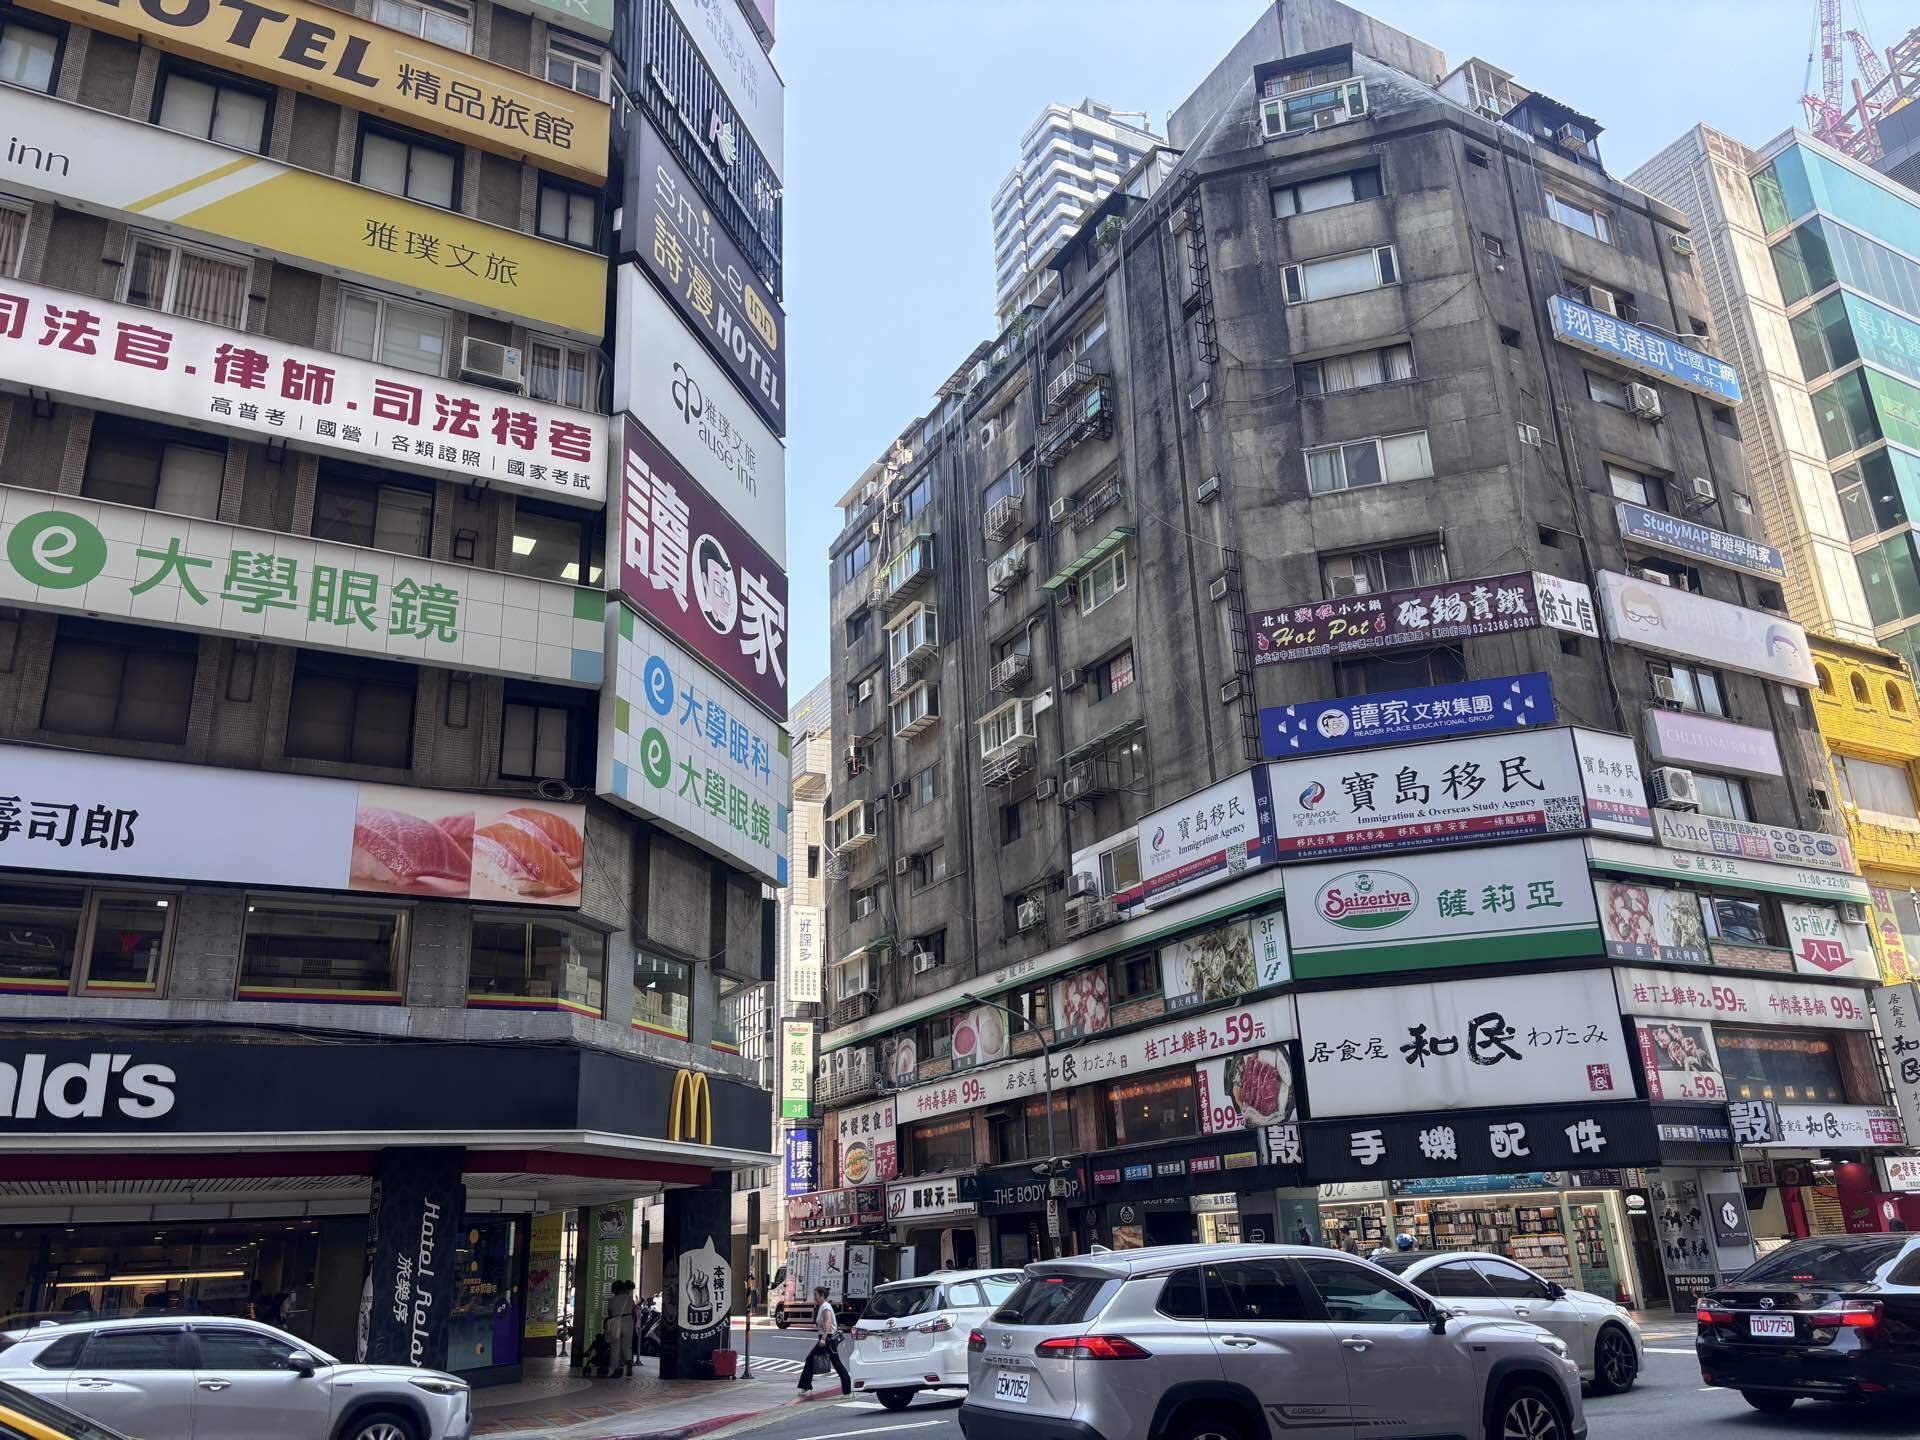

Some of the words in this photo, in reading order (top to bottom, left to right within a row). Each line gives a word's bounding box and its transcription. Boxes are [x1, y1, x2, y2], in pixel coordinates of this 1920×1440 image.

[397, 62, 575, 151] 精品旅館
[8, 137, 70, 177] inn
[364, 218, 519, 288] 雅璞文旅
[655, 217, 714, 330] 詩漫
[716, 303, 780, 411] HOTEL
[1563, 302, 1674, 371] 翔翼通訊
[1673, 345, 1736, 386] 出國上網
[210, 396, 287, 428] 高普考
[316, 418, 364, 445] 國營
[391, 434, 482, 469] 各類證照
[507, 457, 593, 492] 國家考試
[1642, 513, 1710, 545] StudyMAP
[129, 536, 460, 645] 大學眼鏡
[1539, 589, 1595, 634] 徐立信
[1272, 627, 1316, 648] Hot
[1328, 618, 1370, 641] Pot
[1351, 694, 1494, 731] 讀家文教集團
[1354, 727, 1385, 738] READER
[1386, 724, 1411, 734] PLACE
[1412, 718, 1467, 731] EDUCATIONAL
[1468, 714, 1495, 723] GROUP
[679, 686, 771, 785] 大學眼科
[1582, 756, 1639, 781] 寶島移民
[1342, 756, 1546, 814] 寶島移民
[678, 755, 771, 849] 大學眼鏡
[1258, 796, 1270, 825] 四樓
[1292, 809, 1337, 821] FORMOSA
[1357, 810, 1415, 825] Immigration
[1417, 810, 1426, 818] &
[1428, 804, 1471, 816] Overseas
[1472, 801, 1501, 812] Study
[1501, 798, 1537, 810] Agency
[1177, 796, 1246, 841] 寶島移民
[1178, 833, 1220, 856] Immigration
[1220, 823, 1245, 840] Agency
[1261, 835, 1273, 845] 4F
[1296, 834, 1336, 848] 移民台灣
[1326, 888, 1412, 915] Saizeriya
[1437, 880, 1563, 918] 薩莉亞
[1260, 917, 1276, 935] 3F
[1792, 917, 1809, 933] 3F
[1811, 942, 1843, 963] 入口
[1768, 995, 1828, 1017] 牛肉壽喜鍋
[1831, 996, 1863, 1020] 99元
[1308, 1037, 1390, 1065] 居食屋
[1399, 1011, 1524, 1068] 和民
[1528, 1023, 1609, 1048] わたみ
[961, 1078, 988, 1105] 99元
[1213, 1106, 1246, 1131] 99元
[1729, 1101, 1772, 1142] 殼
[1267, 1125, 1303, 1165] 殼
[1350, 1118, 1608, 1167] 手機配件
[796, 1141, 813, 1178] 讀家
[994, 1187, 1014, 1205] THE
[1017, 1183, 1047, 1203] BODY
[713, 1265, 725, 1313] 本棟11F
[1674, 1276, 1710, 1285] BEYOND
[1751, 1319, 1794, 1334] TDU-7750
[992, 1357, 1021, 1365] CROSS
[1291, 1407, 1328, 1416] COROLLA
